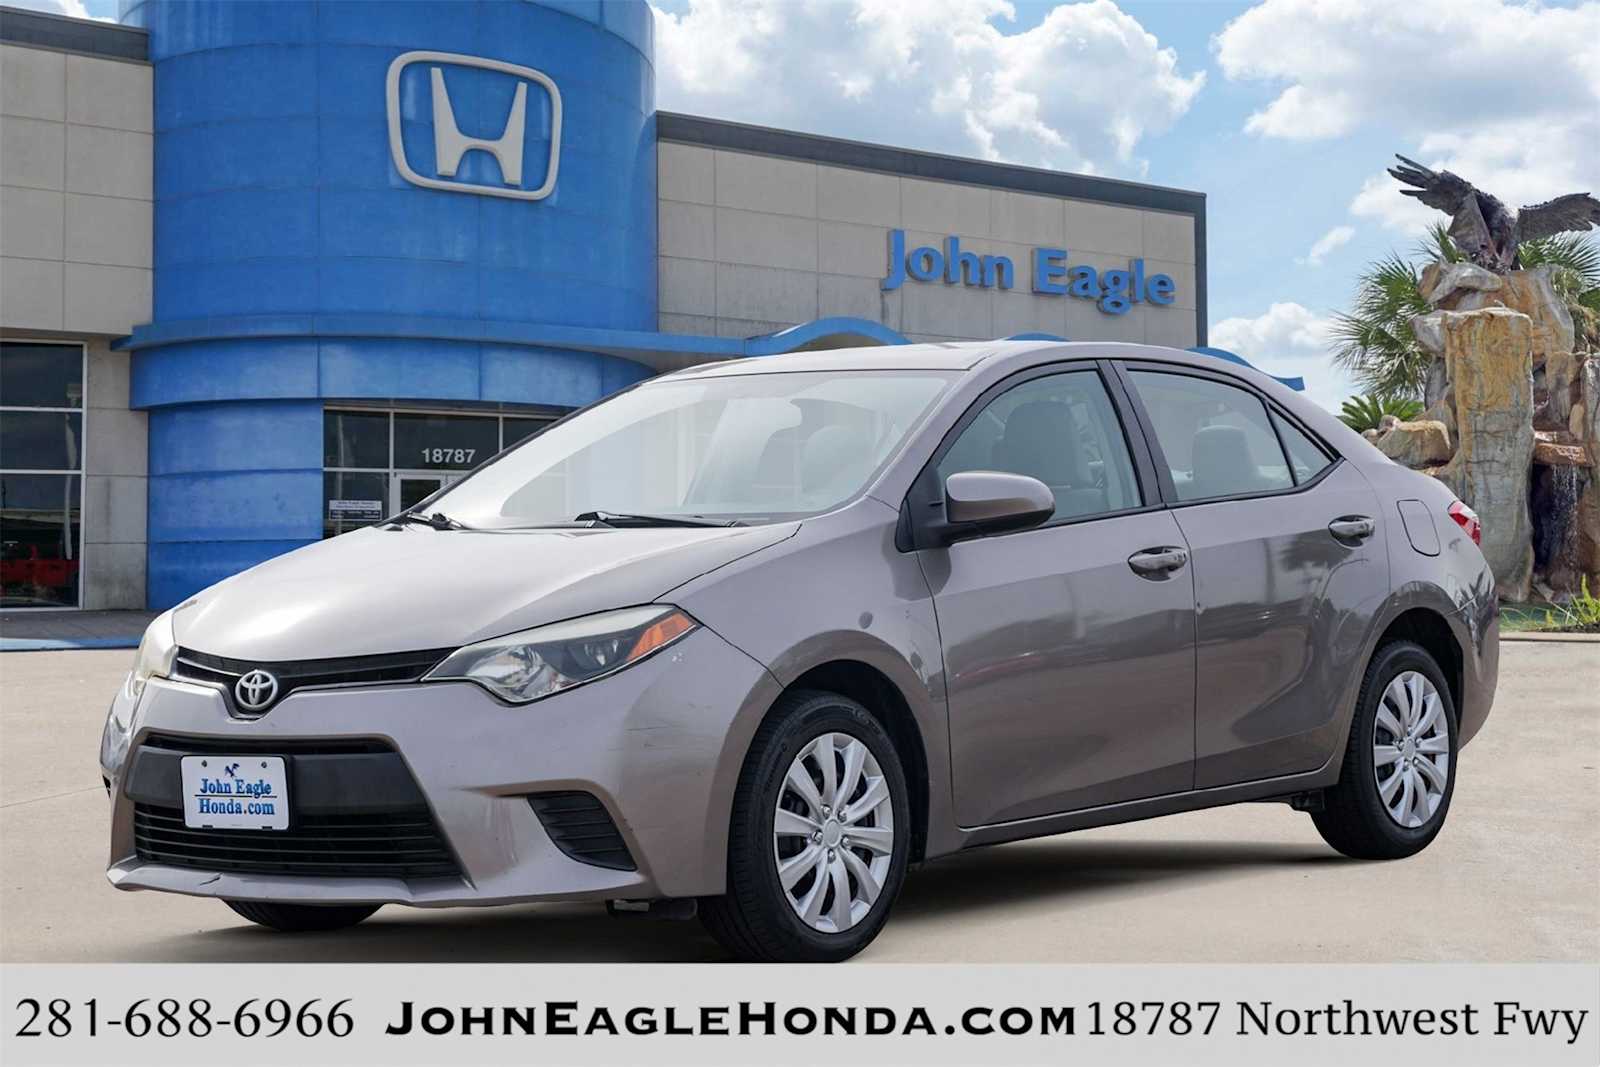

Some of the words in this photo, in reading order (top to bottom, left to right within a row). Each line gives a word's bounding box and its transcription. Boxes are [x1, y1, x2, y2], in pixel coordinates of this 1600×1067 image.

[881, 229, 1014, 291] John
[1032, 247, 1176, 315] Eagle
[421, 448, 476, 464] 18787
[200, 778, 232, 794] John
[235, 779, 272, 798] Eagle
[198, 798, 275, 815] Honda.com
